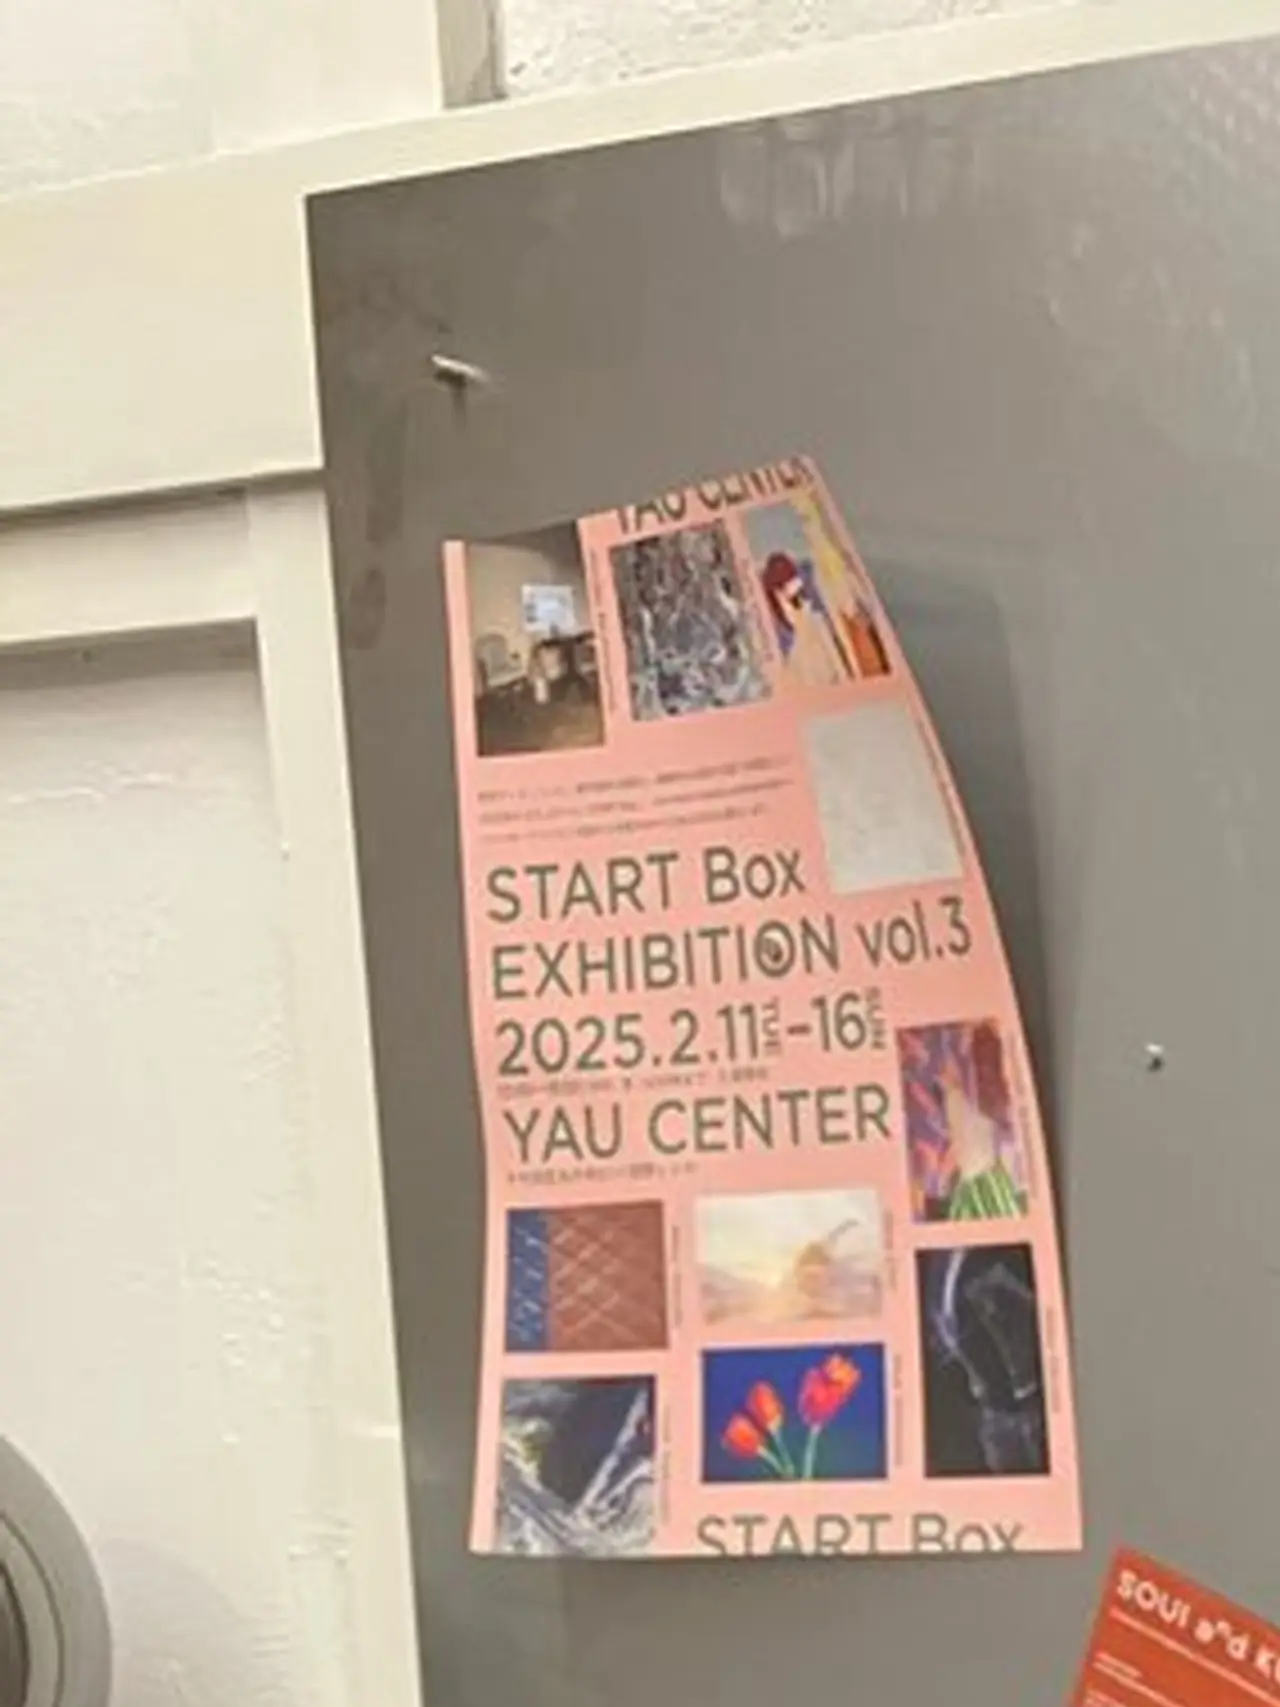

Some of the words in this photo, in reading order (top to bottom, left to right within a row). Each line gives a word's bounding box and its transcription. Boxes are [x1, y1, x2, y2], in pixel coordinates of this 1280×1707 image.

[486, 852, 678, 924] START
[703, 845, 808, 904] Box
[491, 912, 841, 1001] EXHIBITION
[855, 896, 972, 968] vol.3
[503, 1101, 623, 1164] YAU
[648, 1086, 892, 1155] CENTER
[697, 1513, 892, 1555] START
[911, 1512, 1023, 1554] Box
